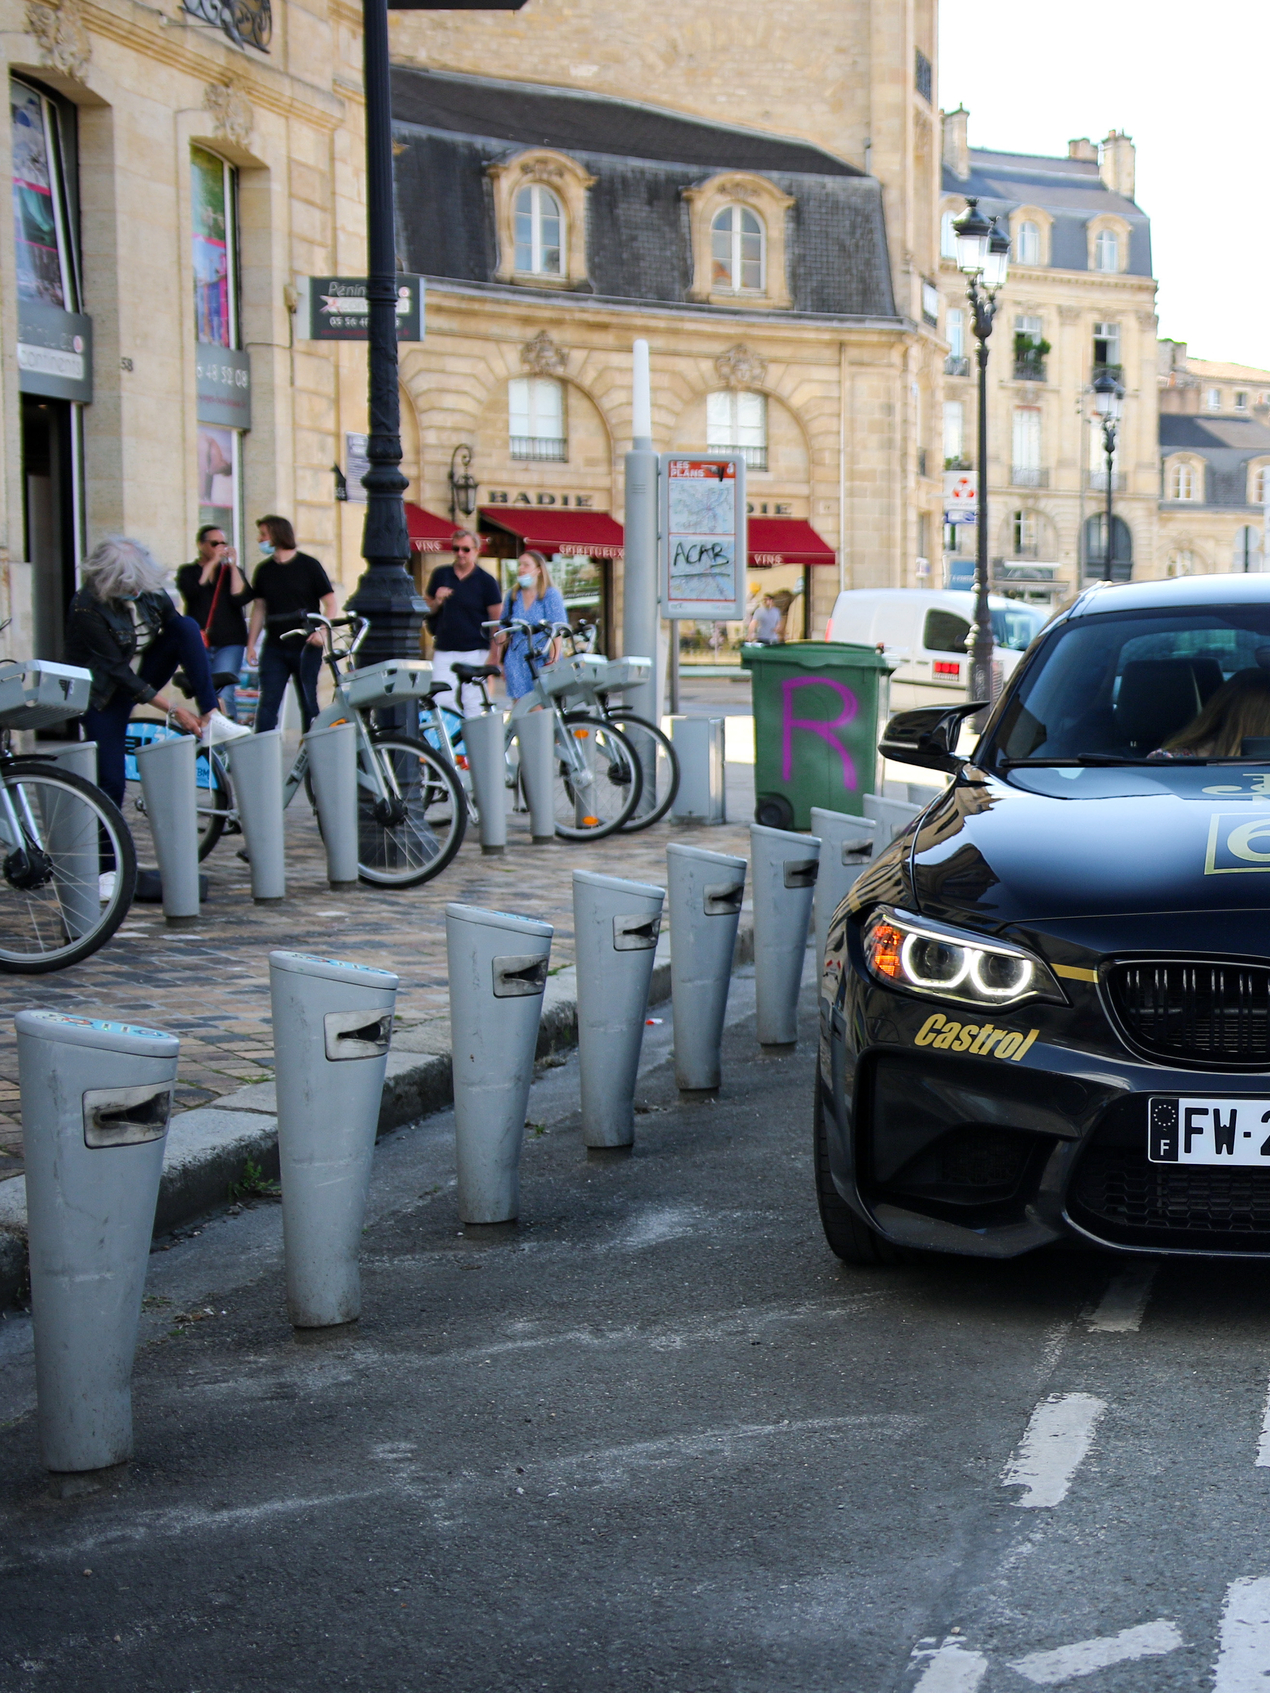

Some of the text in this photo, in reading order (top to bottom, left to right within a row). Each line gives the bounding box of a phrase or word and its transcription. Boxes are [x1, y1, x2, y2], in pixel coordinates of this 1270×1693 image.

[671, 461, 690, 469] LES
[671, 469, 706, 478] PLANS
[487, 491, 593, 507] BADIE
[747, 502, 792, 515] DIE
[415, 539, 442, 552] VINS
[673, 542, 730, 568] ACAB
[753, 553, 783, 566] VINS
[782, 676, 858, 791] R
[914, 1013, 1040, 1062] Castrol
[1159, 1138, 1171, 1156] F
